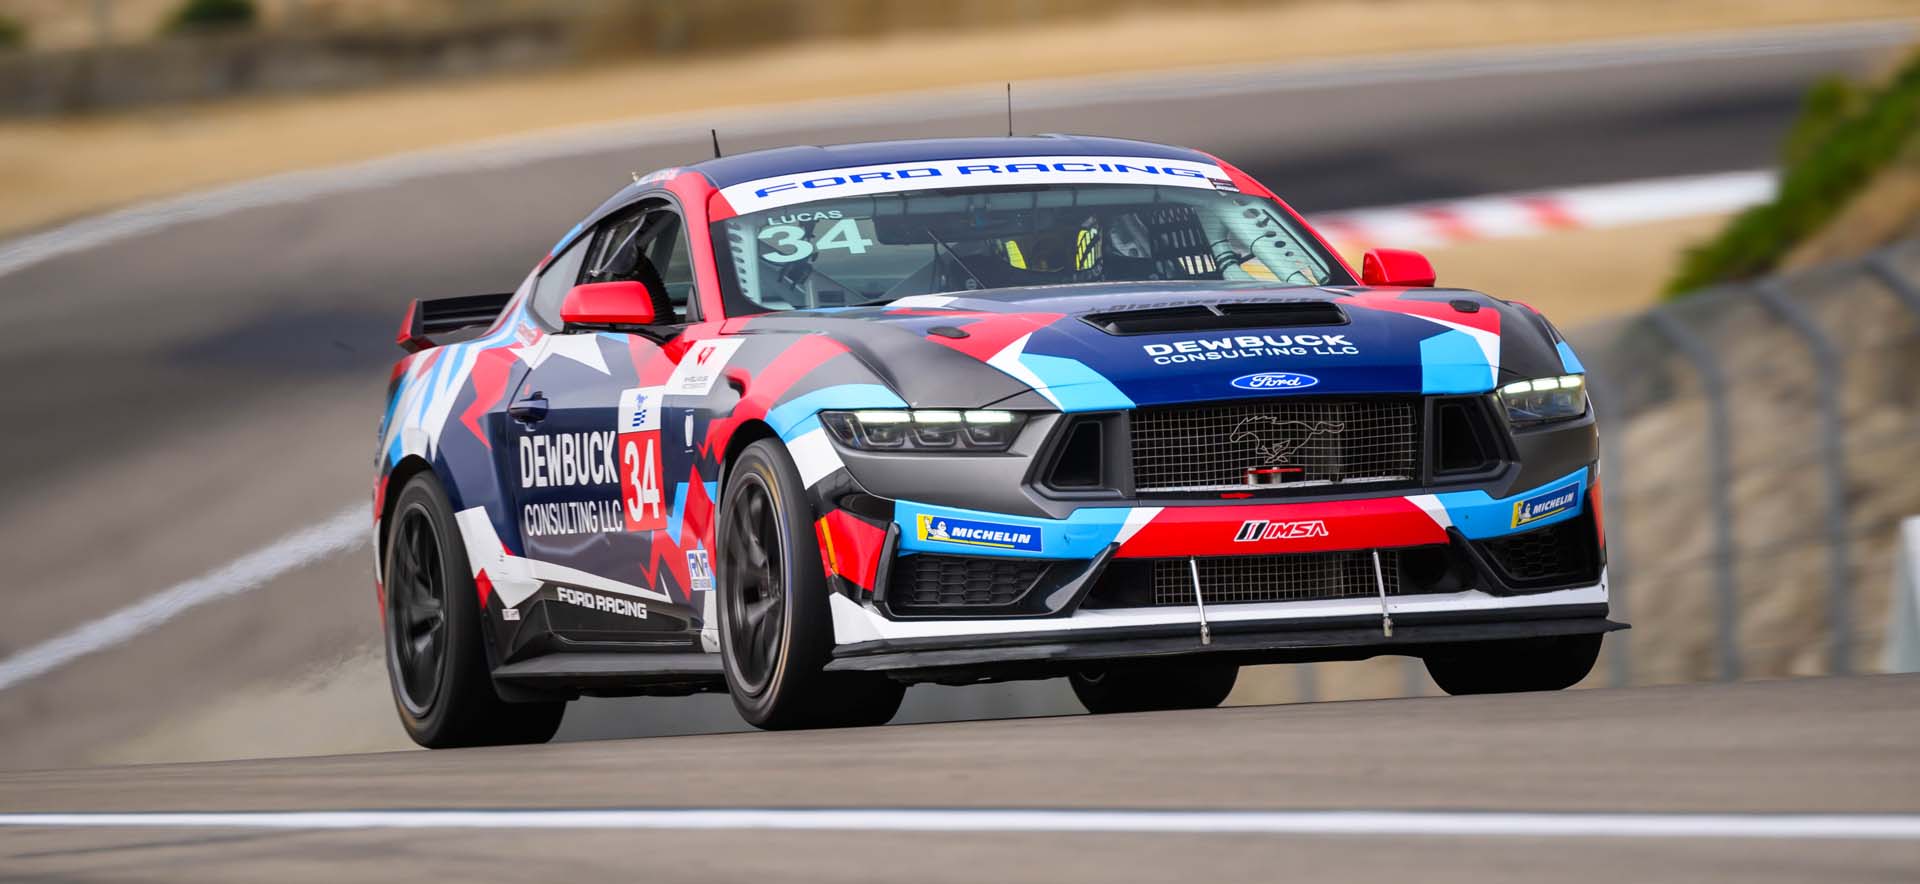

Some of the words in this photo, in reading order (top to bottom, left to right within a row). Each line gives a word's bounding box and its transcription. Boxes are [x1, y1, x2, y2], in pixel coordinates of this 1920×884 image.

[755, 167, 942, 198] FORD
[956, 162, 1206, 178] RACING
[767, 210, 843, 226] LUCAS
[757, 218, 873, 263] 34
[1143, 334, 1353, 356] DEWBUCK
[1153, 346, 1307, 365] CONSULTING
[1310, 346, 1360, 355] LLC
[1249, 373, 1302, 387] Ford
[519, 430, 619, 488] DEWBUCK
[624, 438, 661, 522] 34
[1532, 491, 1575, 514] MICHELIN
[524, 500, 599, 537] CONSULTING
[598, 499, 623, 533] LLC
[1263, 520, 1329, 539] IMSA
[951, 527, 1032, 544] MICHELIN
[556, 586, 596, 610] FORD
[596, 594, 648, 620] RACING
